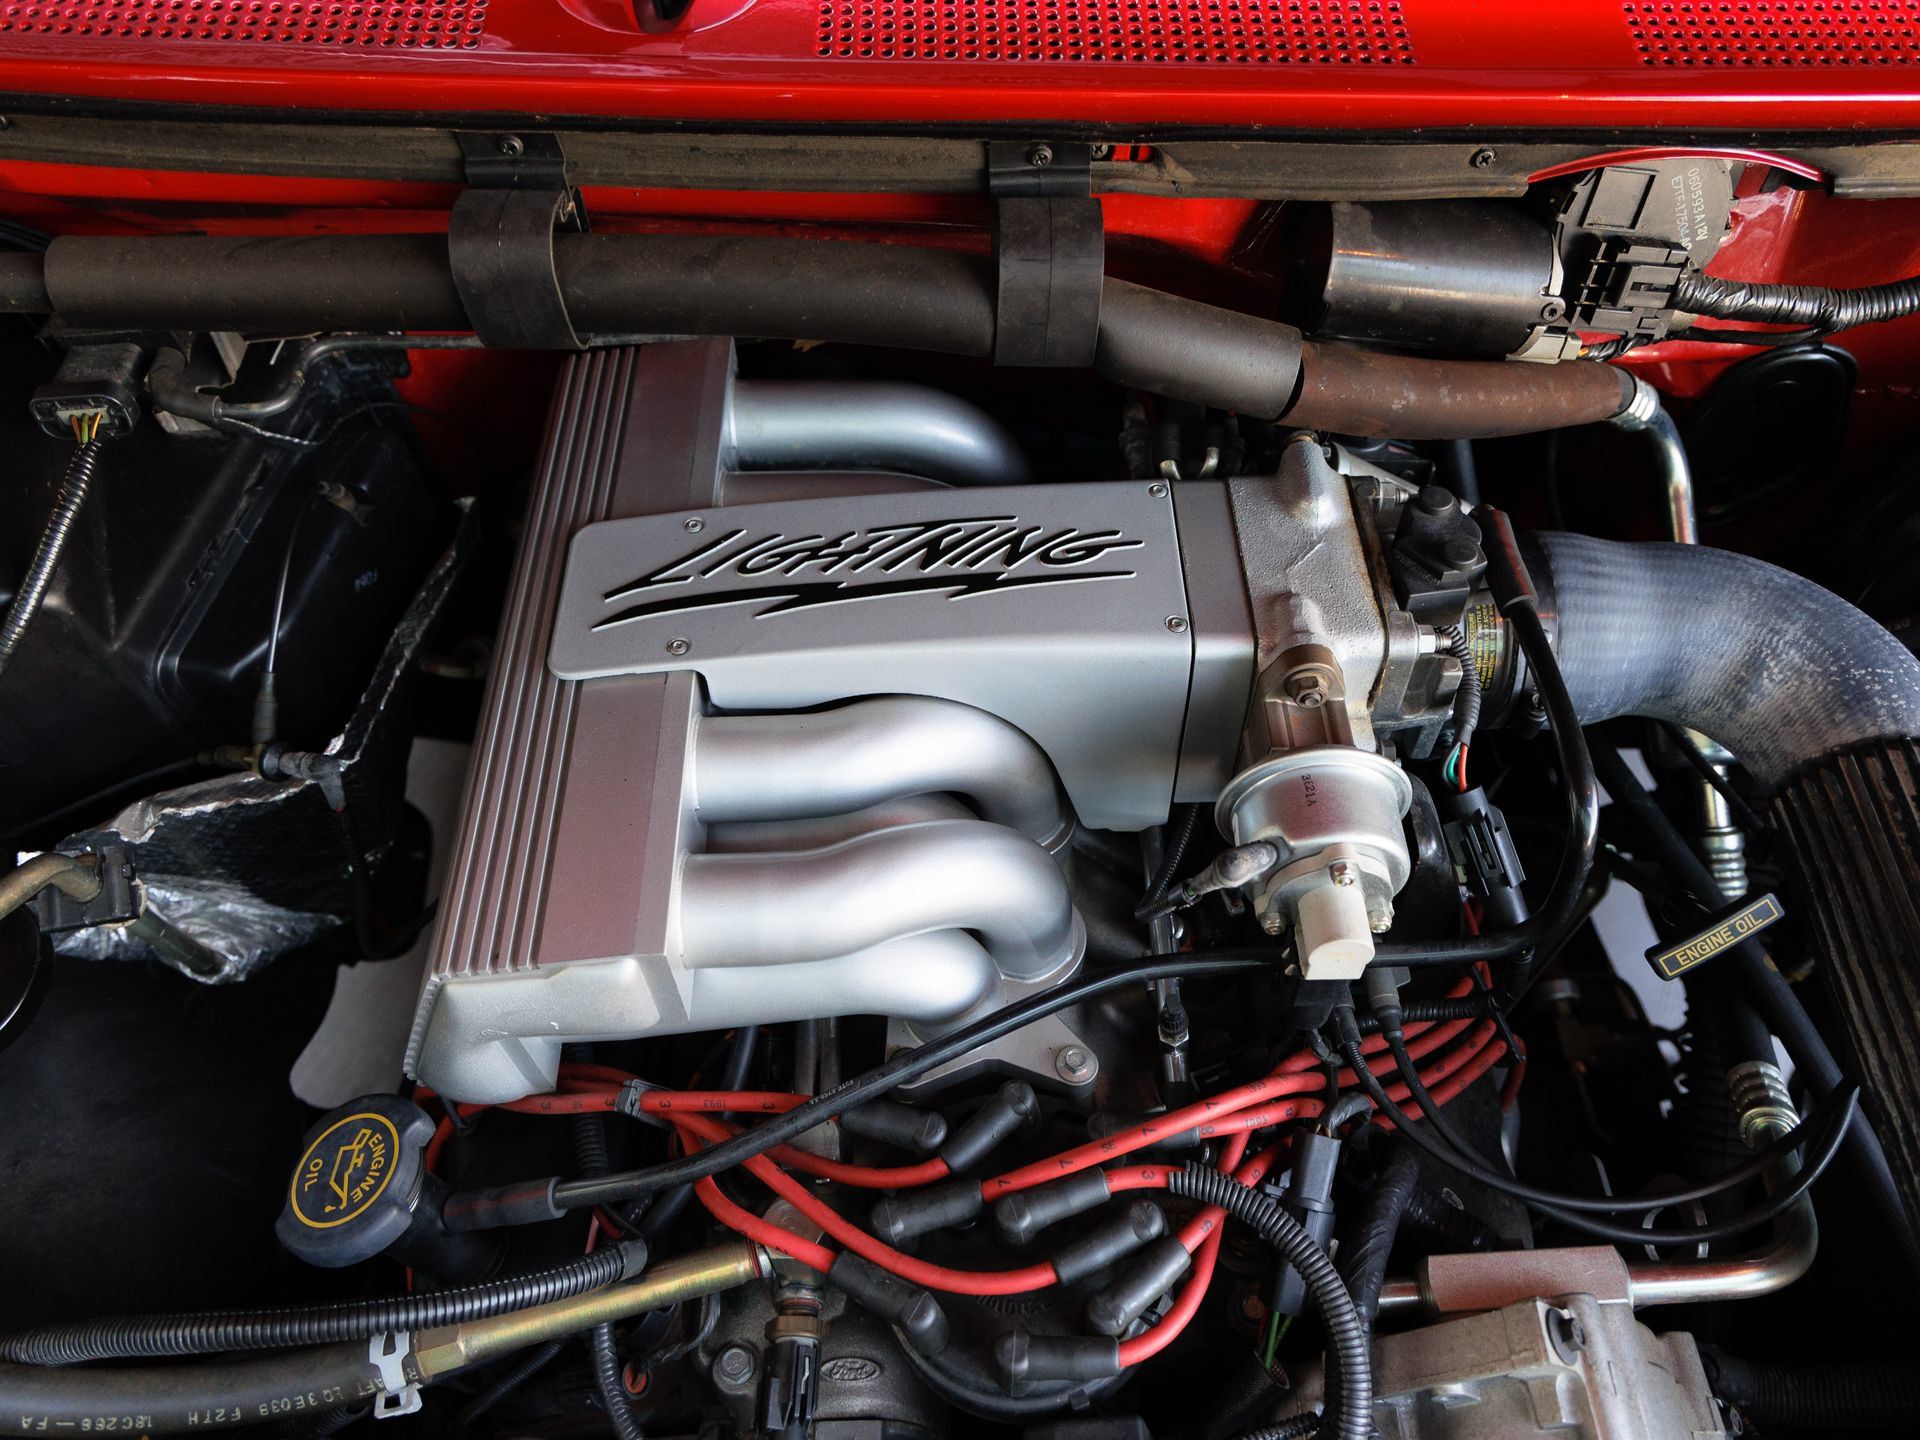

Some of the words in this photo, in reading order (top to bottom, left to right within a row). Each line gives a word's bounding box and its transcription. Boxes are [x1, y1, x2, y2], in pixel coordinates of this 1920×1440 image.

[603, 515, 1145, 603] LIGHTNING
[1676, 927, 1734, 966] ENGINE
[1735, 913, 1763, 934] OIL
[304, 1158, 323, 1192] OIL
[351, 1133, 386, 1203] ENGINE
